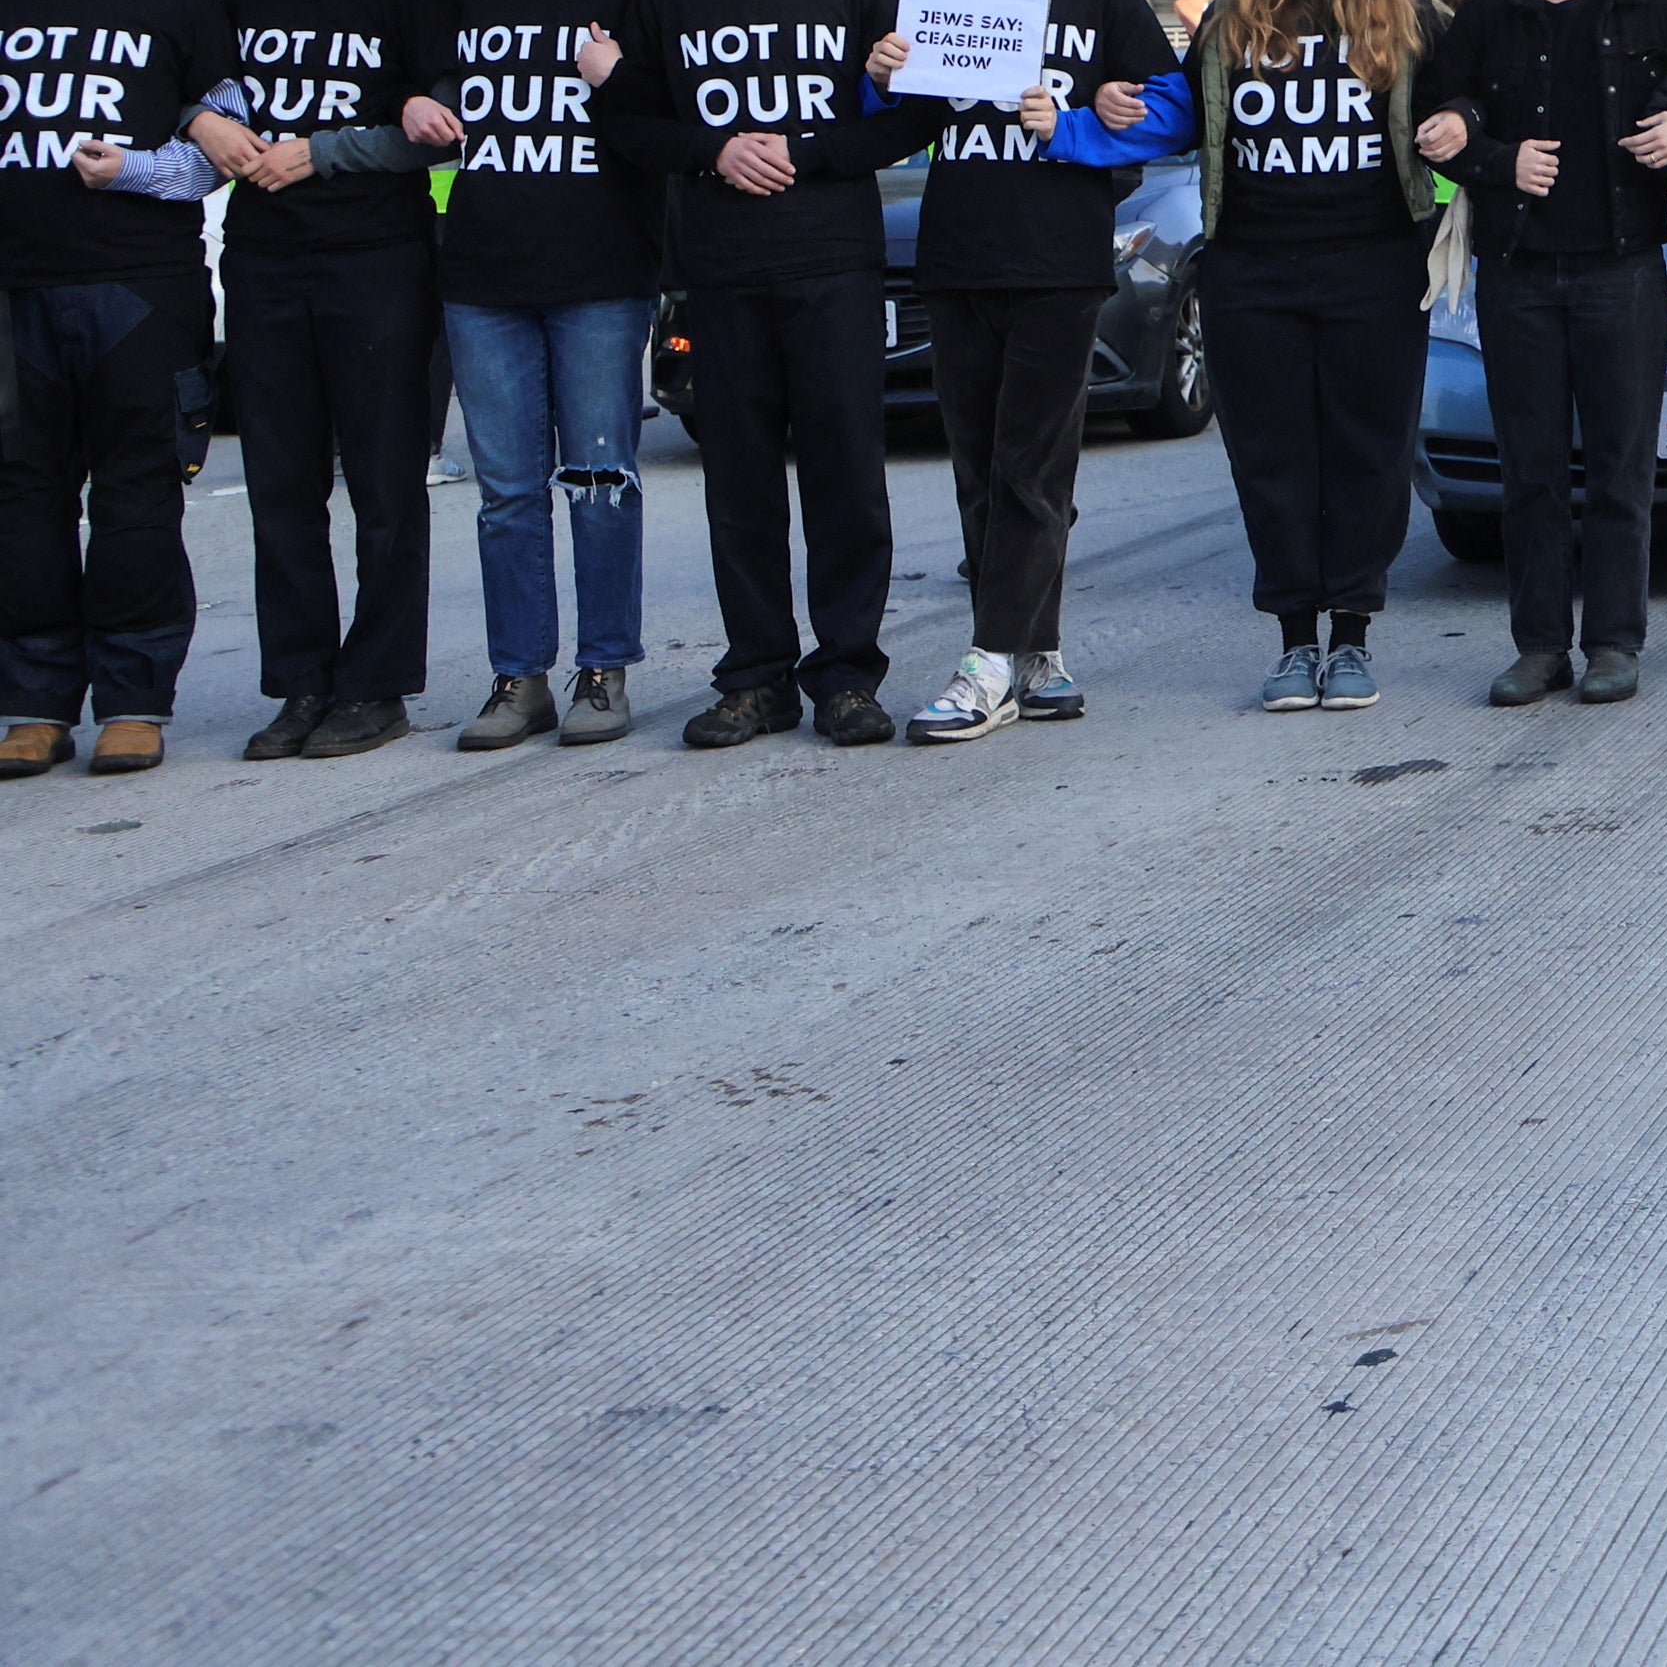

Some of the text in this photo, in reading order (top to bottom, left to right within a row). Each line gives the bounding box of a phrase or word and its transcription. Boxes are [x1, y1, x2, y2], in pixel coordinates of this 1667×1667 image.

[919, 10, 1023, 31] JEWS SAY:
[0, 26, 151, 68] OT IN
[328, 32, 381, 69] IN
[458, 25, 542, 64] NOT
[680, 24, 846, 69] NOT IN
[915, 30, 1023, 52] CEASEFIRE
[1044, 23, 1096, 62] IN
[942, 53, 992, 70] NOW
[460, 75, 592, 123] OUR
[696, 74, 836, 127] OUR
[1233, 78, 1373, 126] OUR
[460, 134, 600, 173] AME
[1232, 133, 1383, 173] NAME
